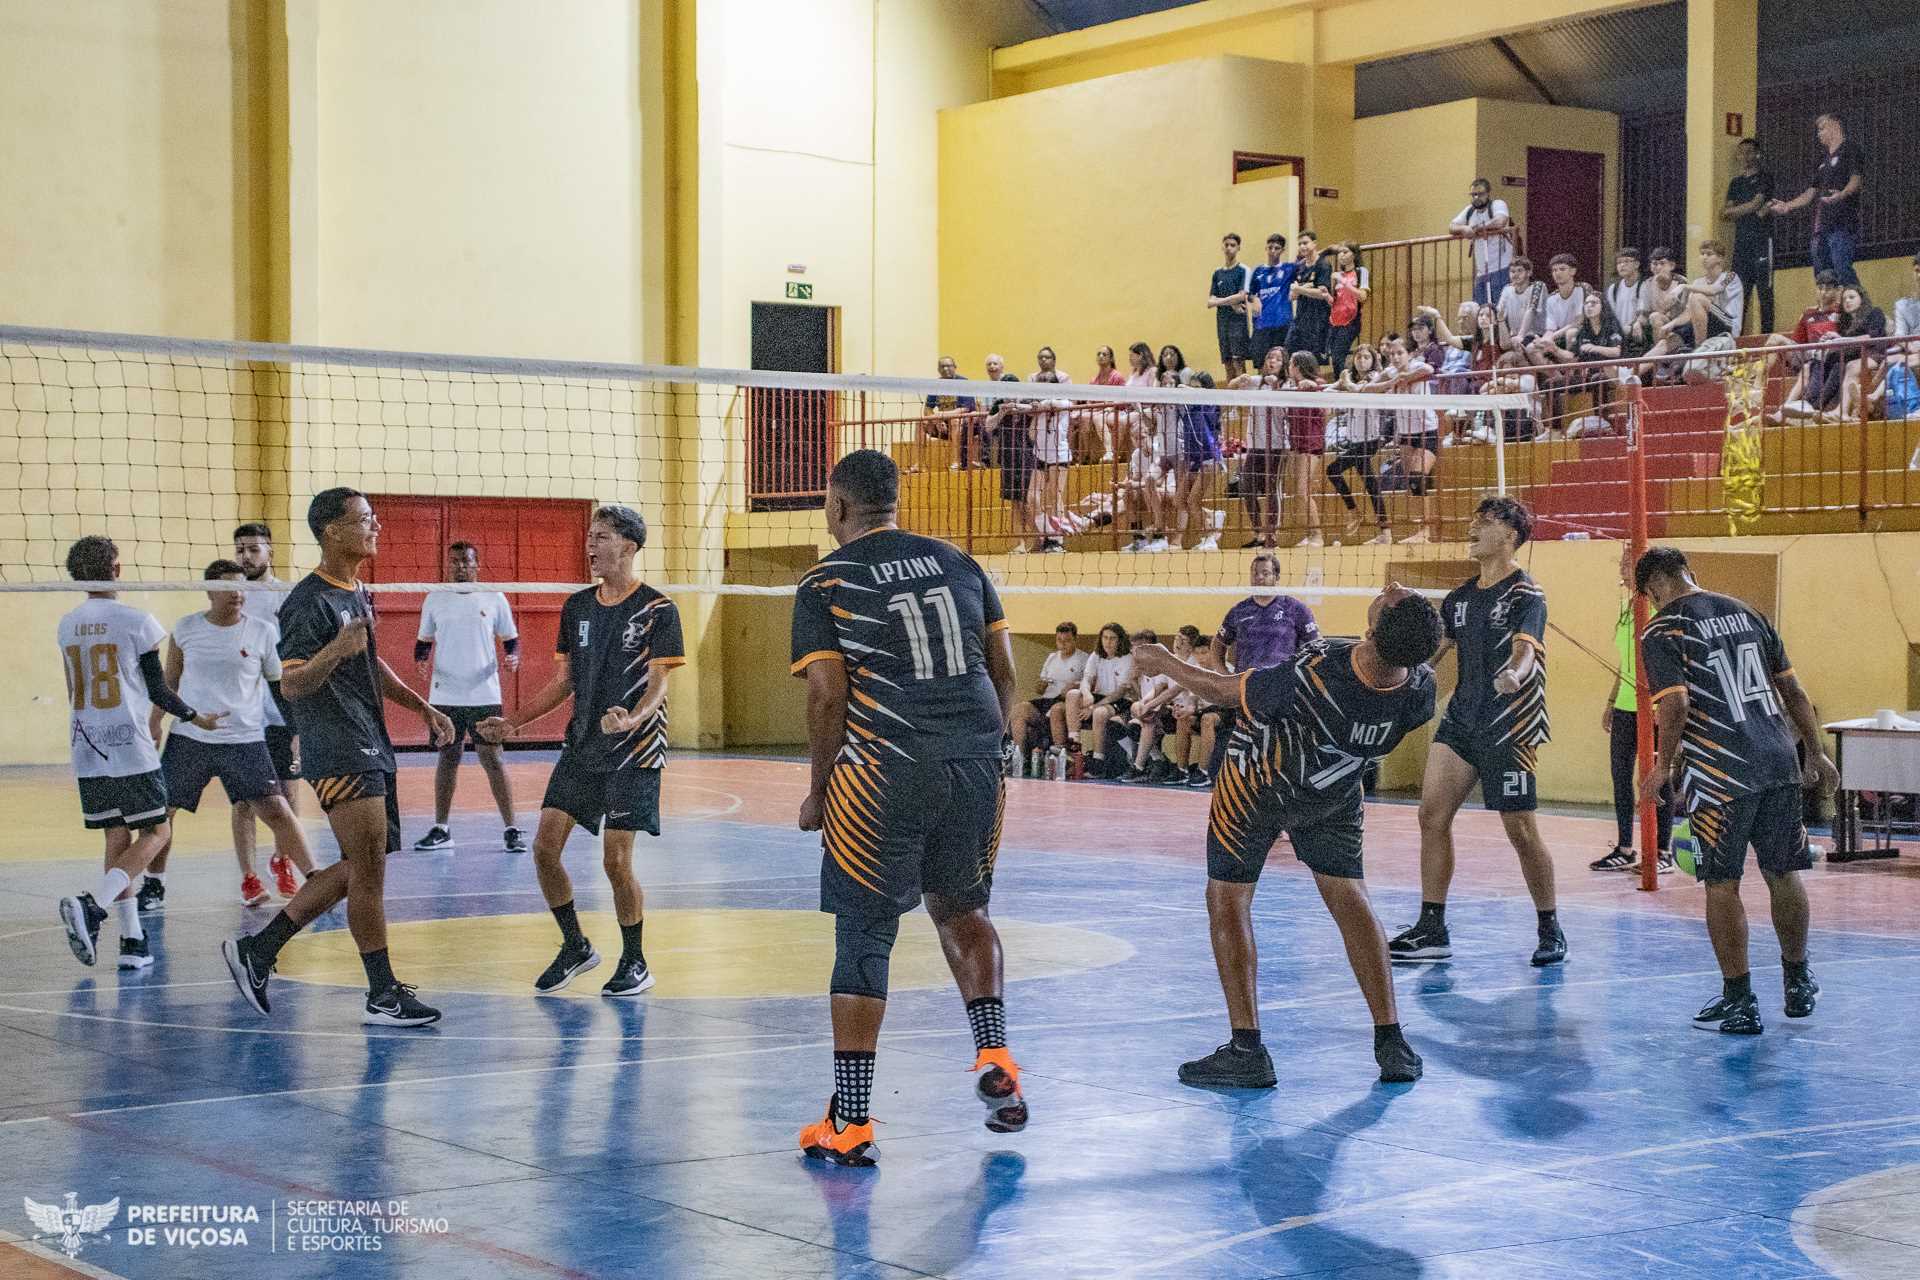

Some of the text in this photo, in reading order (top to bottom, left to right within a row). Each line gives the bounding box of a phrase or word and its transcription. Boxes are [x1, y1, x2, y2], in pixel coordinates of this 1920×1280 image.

[869, 555, 943, 585] LPZINN
[1454, 602, 1468, 627] 21
[74, 623, 108, 637] LUCAS
[579, 621, 590, 646] 9
[887, 586, 967, 680] 11
[65, 643, 122, 710] 18
[1706, 642, 1779, 723] 14
[1503, 771, 1528, 796] 21
